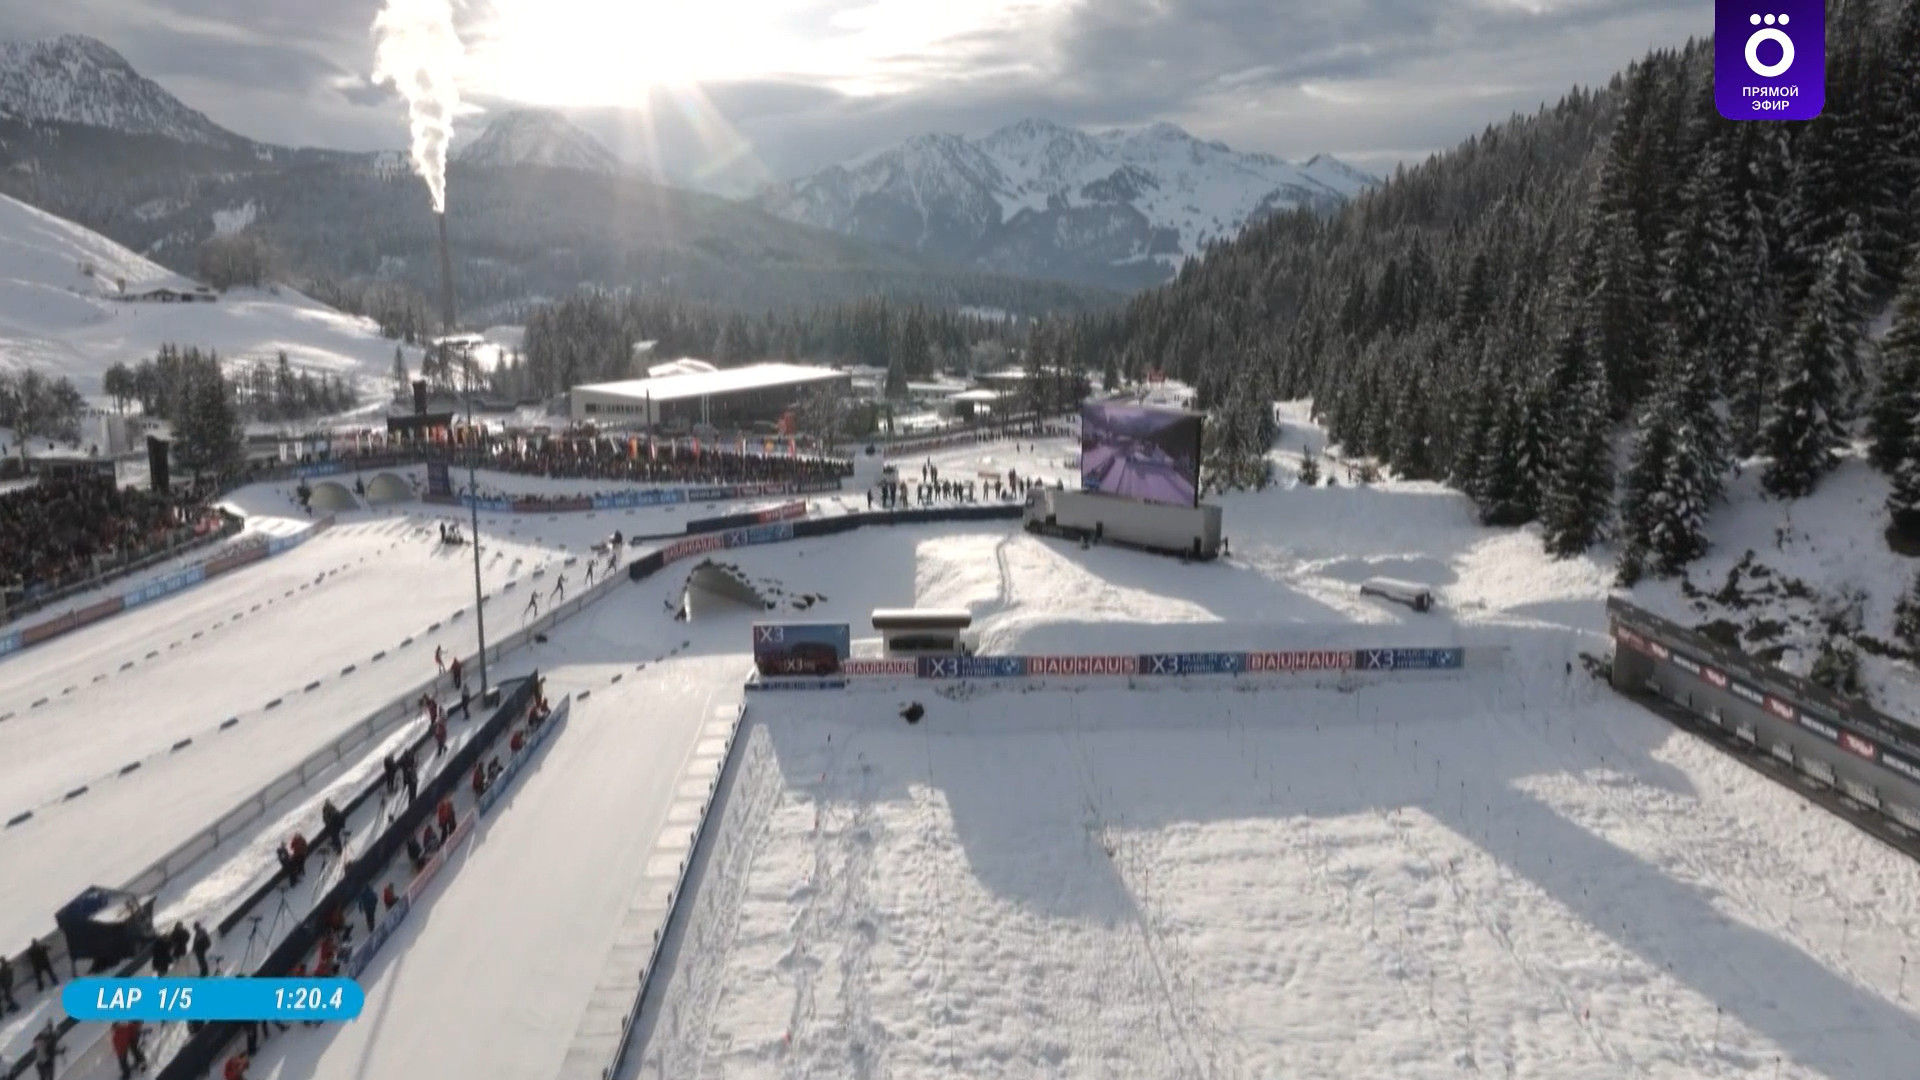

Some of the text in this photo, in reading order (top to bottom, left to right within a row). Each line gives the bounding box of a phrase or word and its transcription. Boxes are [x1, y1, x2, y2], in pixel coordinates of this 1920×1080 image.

[931, 657, 958, 678] X3
[1032, 656, 1134, 674] BAUHAUS
[1152, 654, 1178, 674] X3
[1251, 652, 1350, 670] BAUHAUS
[1368, 650, 1394, 669] X3
